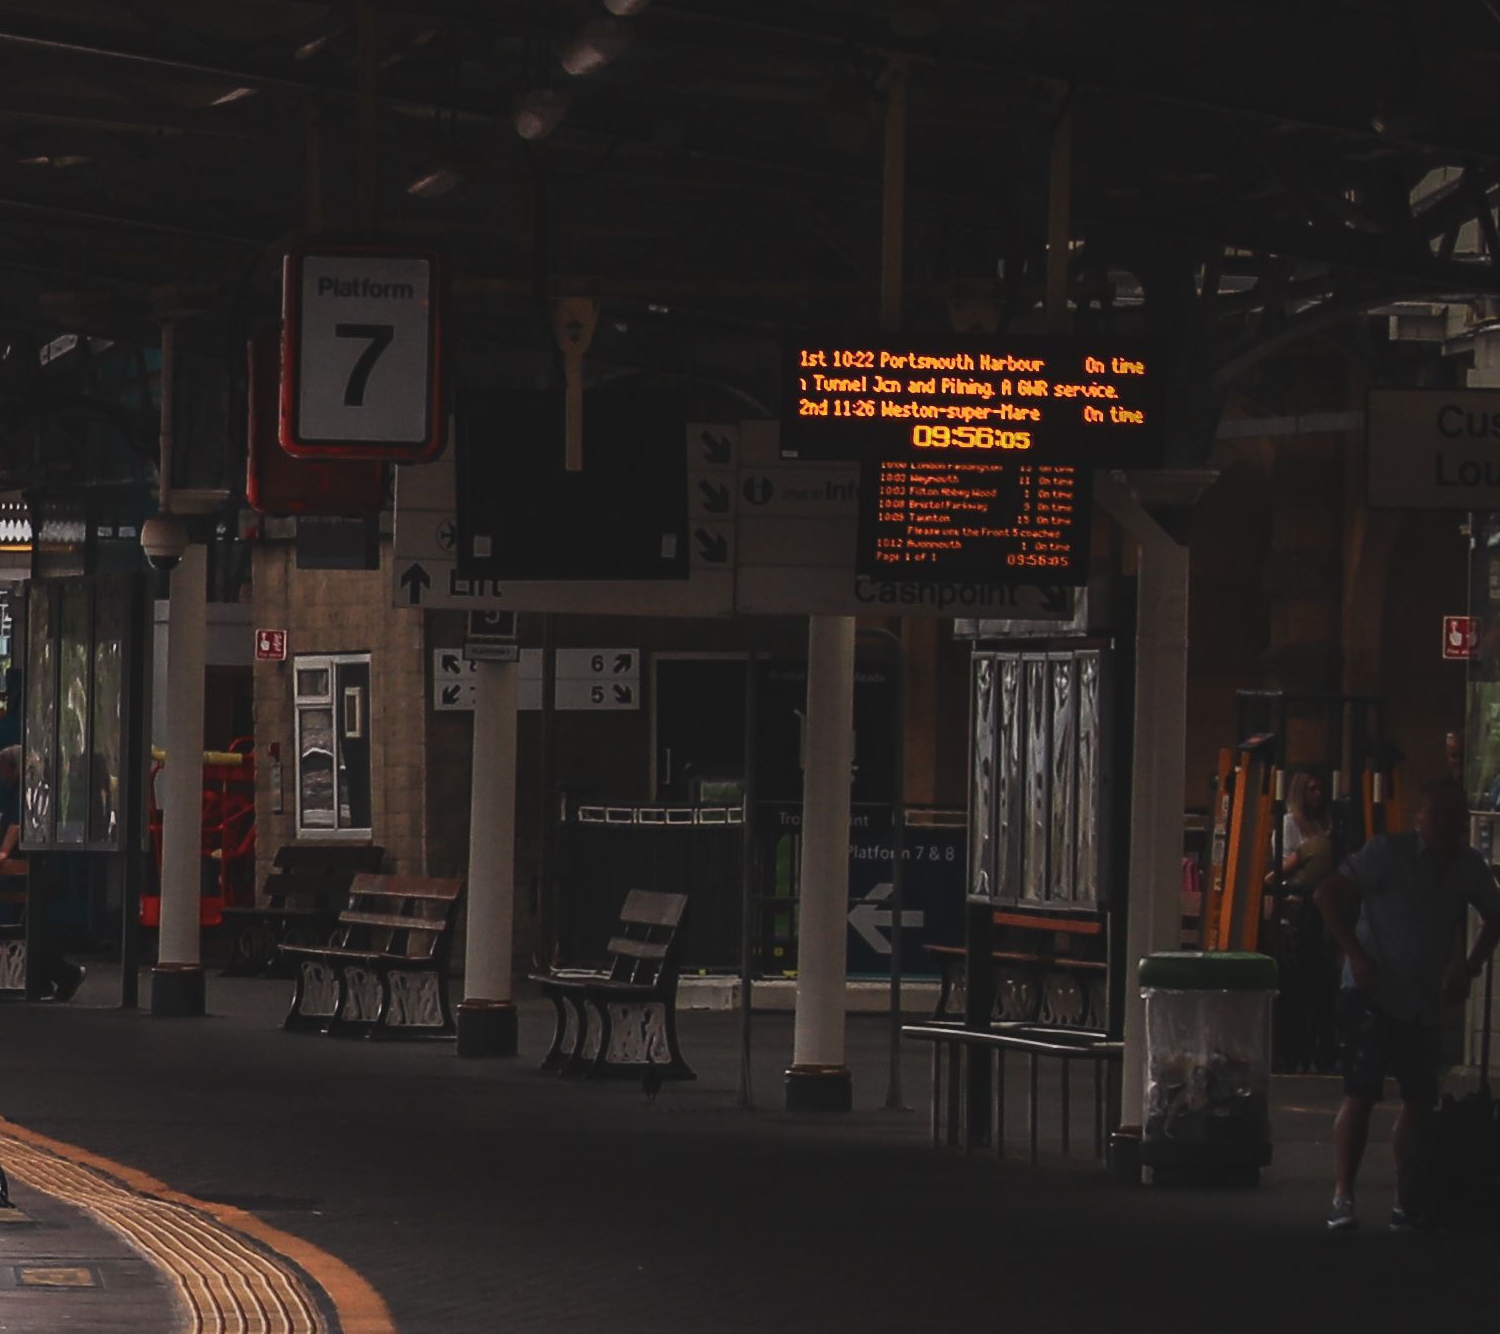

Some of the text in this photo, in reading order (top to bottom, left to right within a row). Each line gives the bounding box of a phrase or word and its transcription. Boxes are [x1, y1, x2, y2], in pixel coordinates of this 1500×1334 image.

[318, 278, 413, 299] Platform
[335, 324, 393, 407] 7
[800, 350, 1145, 375] 1st 10:22 Portsmouth Harbour On time
[812, 373, 867, 393] Tunnel
[872, 375, 902, 393] Jcn
[907, 377, 936, 395] and
[1001, 378, 1012, 396] A
[1017, 379, 1049, 397] GWR
[1053, 381, 1119, 399] service.
[799, 398, 1144, 424] 2nd 11:26 Weston-super-Mare On time
[912, 424, 1031, 450] 09:56:05
[909, 514, 951, 523] Taunton
[855, 574, 1018, 608] Cashpoint
[591, 656, 604, 673] 6
[591, 686, 604, 704] 5
[916, 846, 924, 860] 7
[929, 847, 941, 861] &
[945, 847, 955, 861] 8
